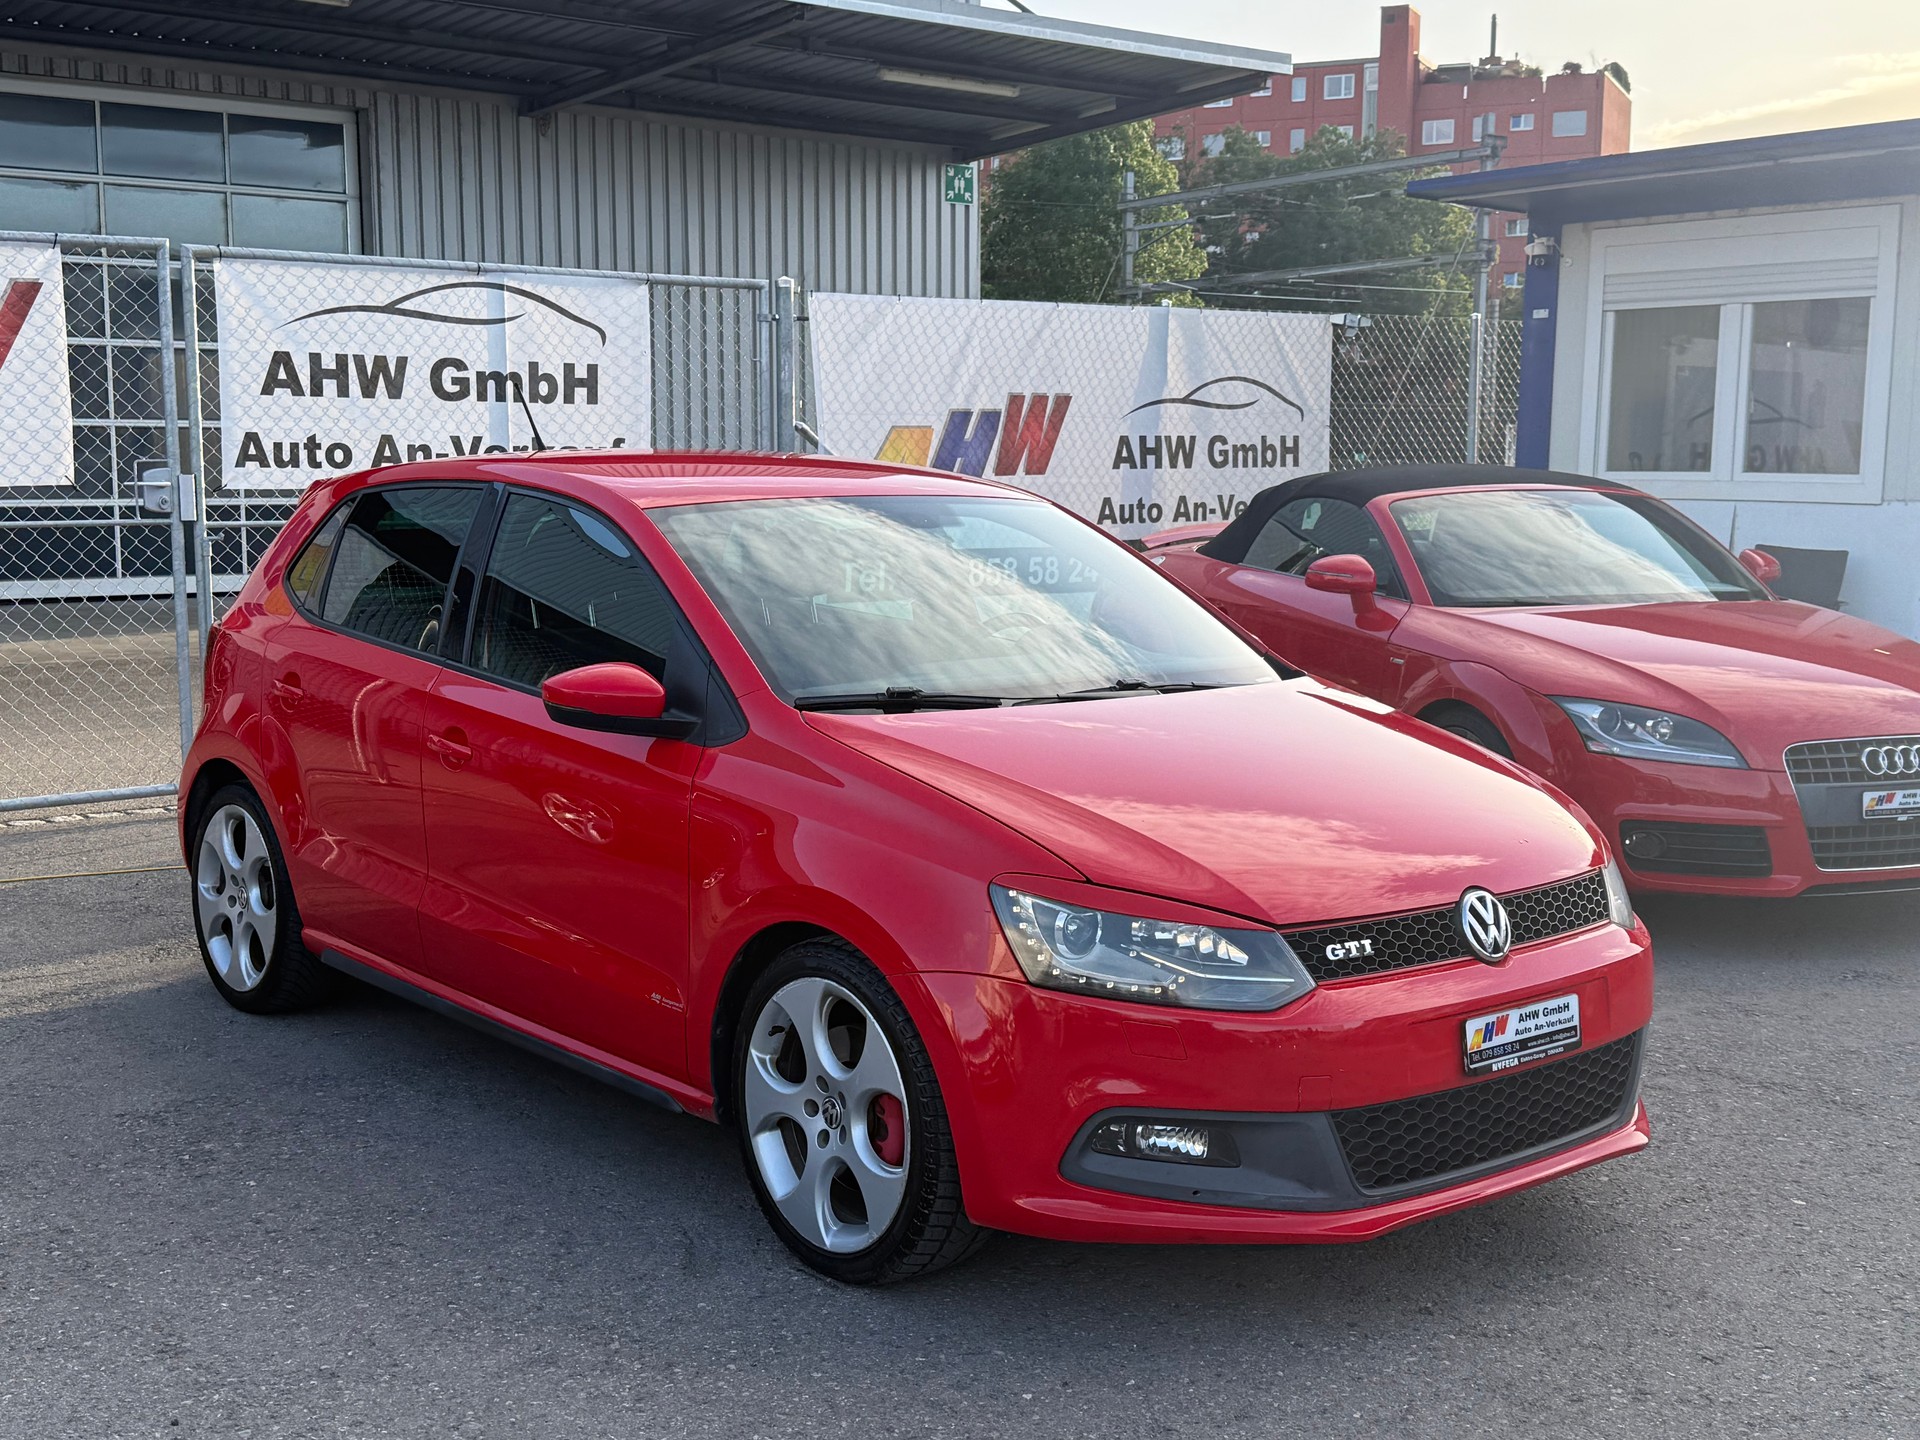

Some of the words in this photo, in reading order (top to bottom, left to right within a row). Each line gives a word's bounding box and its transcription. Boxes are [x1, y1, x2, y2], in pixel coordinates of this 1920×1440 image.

[260, 350, 408, 400] AHW
[429, 356, 599, 405] GmbH
[234, 431, 354, 470] Auto
[1112, 435, 1197, 470] AHW
[1207, 434, 1300, 469] GmbH
[1096, 496, 1163, 525] Auto
[1172, 494, 1249, 523] An-Ve
[840, 561, 894, 593] Tel.
[1028, 555, 1060, 585] 58
[1325, 939, 1375, 961] GTI
[1515, 1027, 1532, 1037] Auto
[1534, 1014, 1575, 1031] An-Verkauf
[1518, 1009, 1540, 1024] AHW
[1542, 1002, 1570, 1018] GmbH
[1470, 1014, 1510, 1051] AHW
[1482, 1049, 1493, 1059] 079
[1513, 1042, 1520, 1051] 24
[1492, 1057, 1519, 1072] NYFEGA
